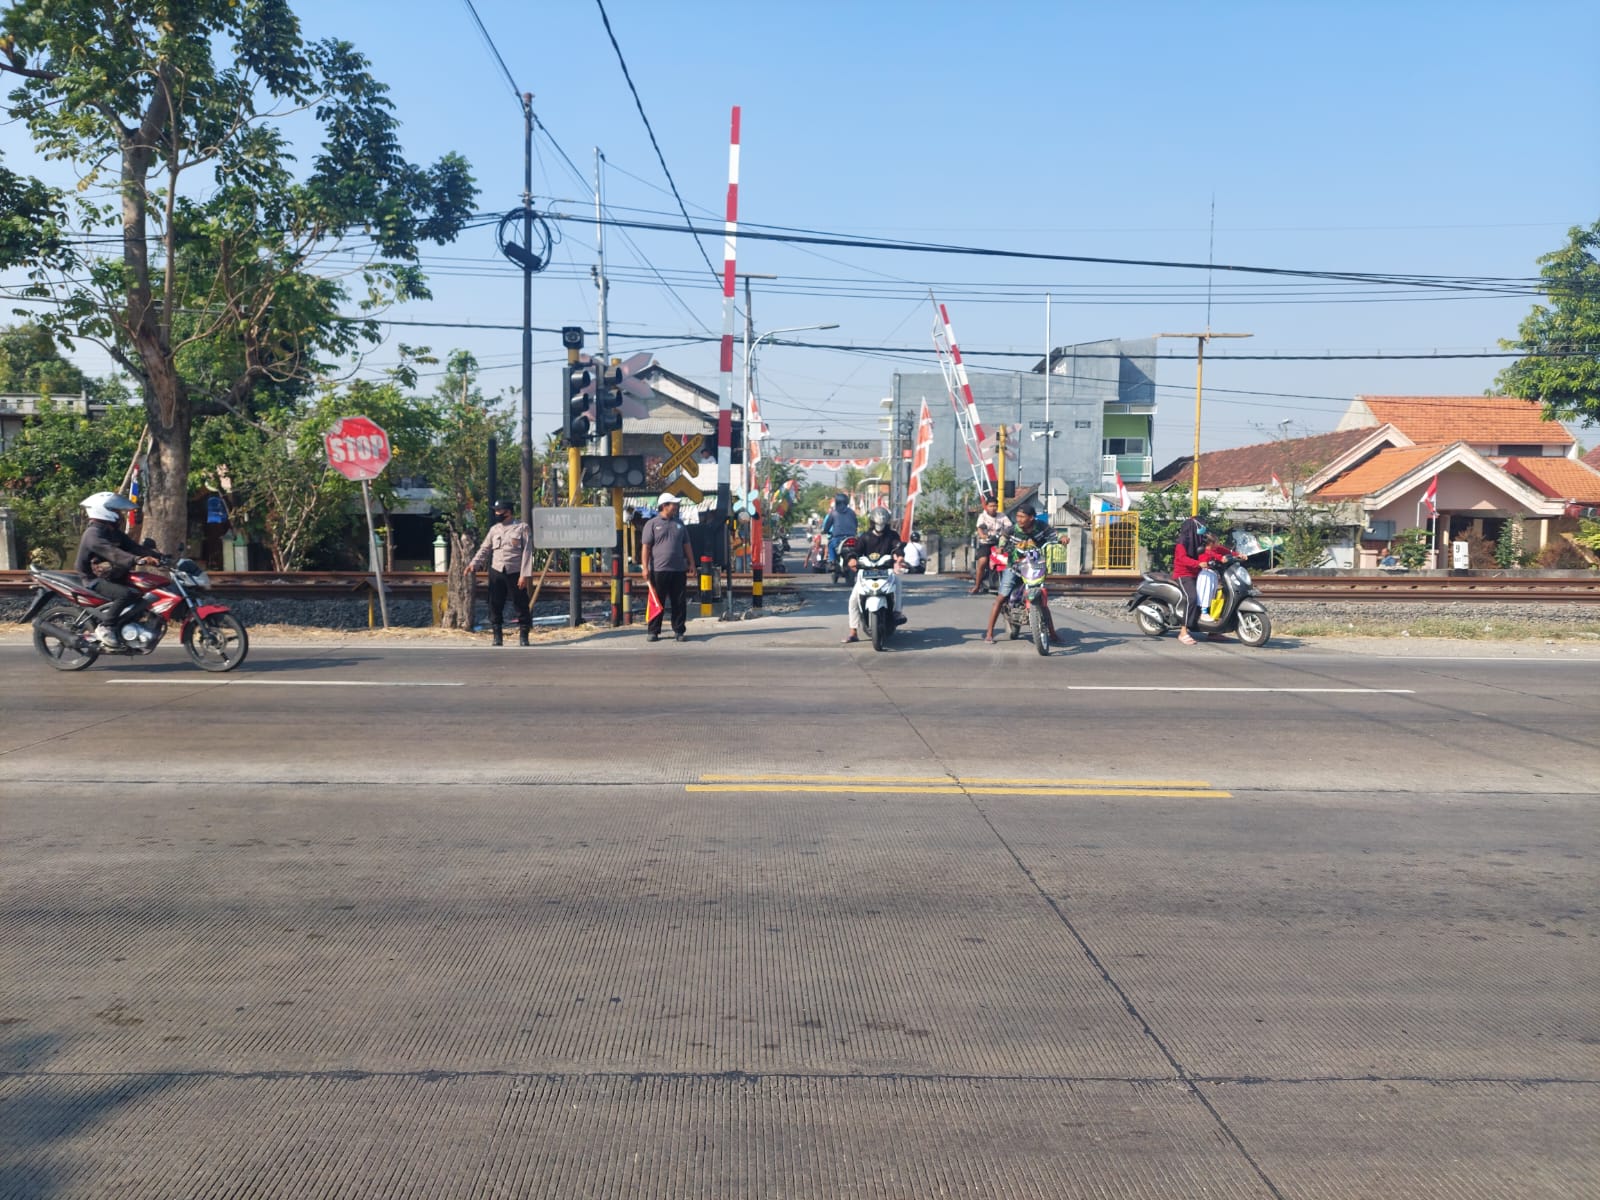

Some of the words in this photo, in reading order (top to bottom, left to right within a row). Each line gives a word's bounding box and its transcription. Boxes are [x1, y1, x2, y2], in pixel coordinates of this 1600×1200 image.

[330, 434, 384, 463] STOP
[547, 514, 570, 526] HATI
[579, 513, 602, 526] HATI
